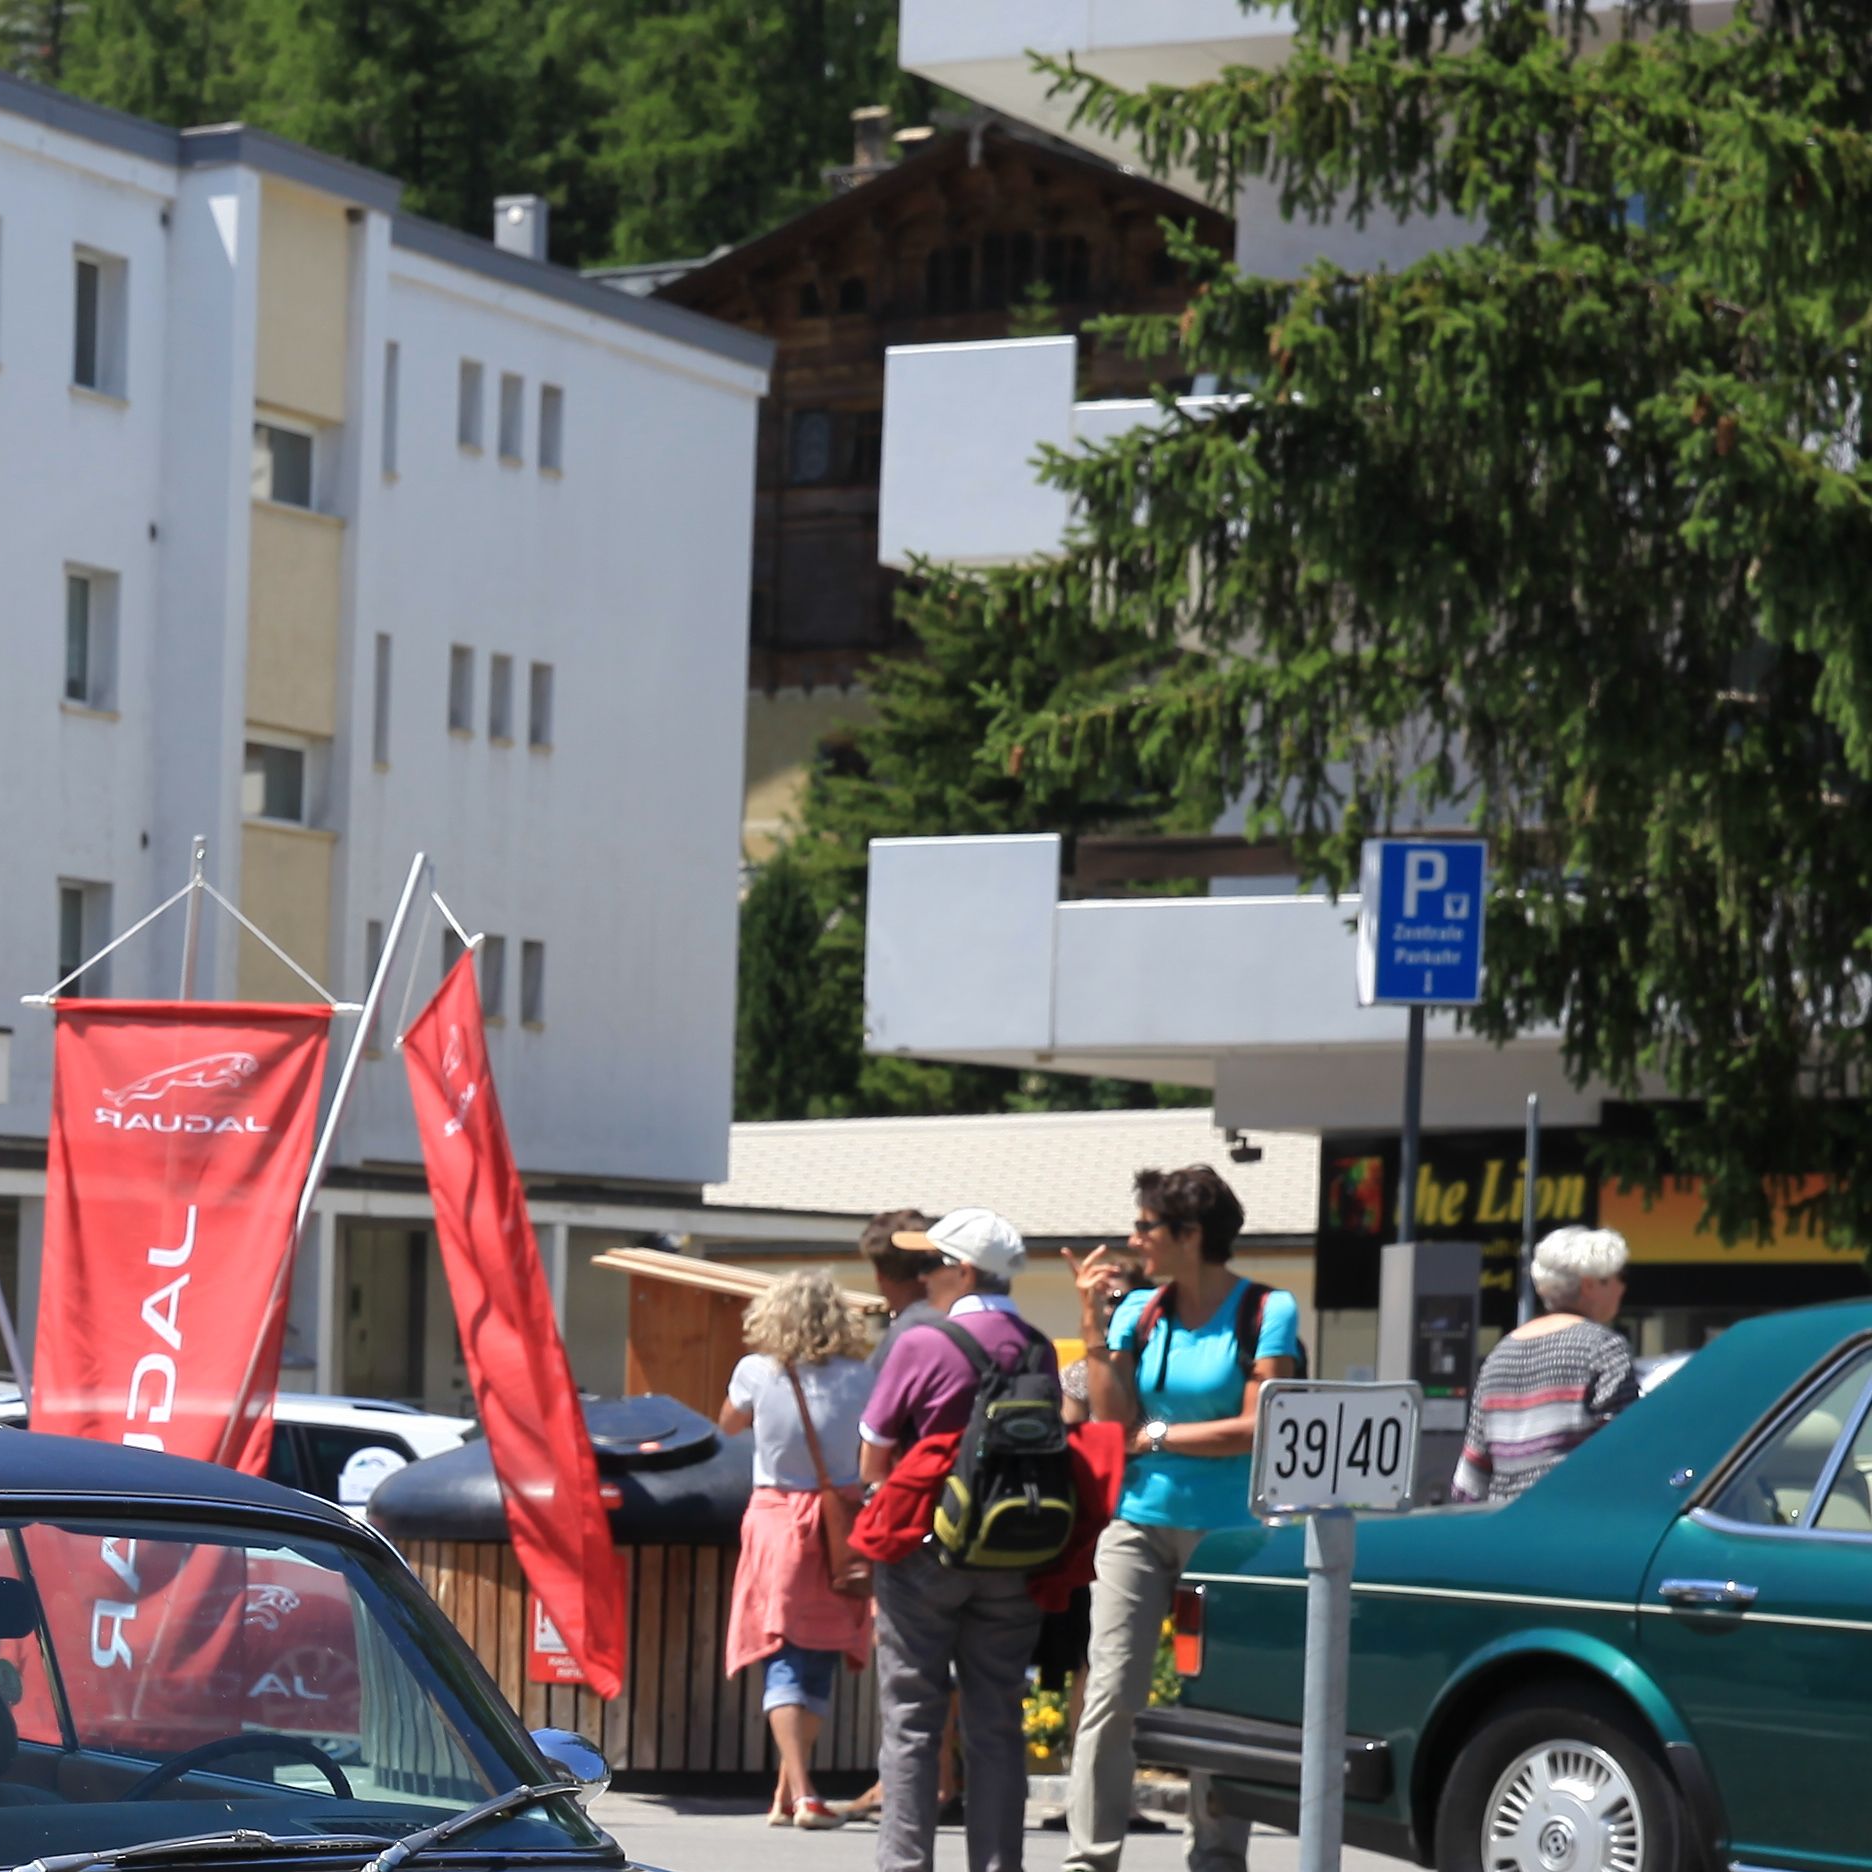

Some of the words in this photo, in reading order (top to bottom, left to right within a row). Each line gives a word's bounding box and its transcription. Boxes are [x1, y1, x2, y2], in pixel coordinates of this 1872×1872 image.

[1403, 850, 1448, 918] P
[1392, 922, 1464, 942] Zentrale
[1394, 946, 1462, 965] Parkuhr
